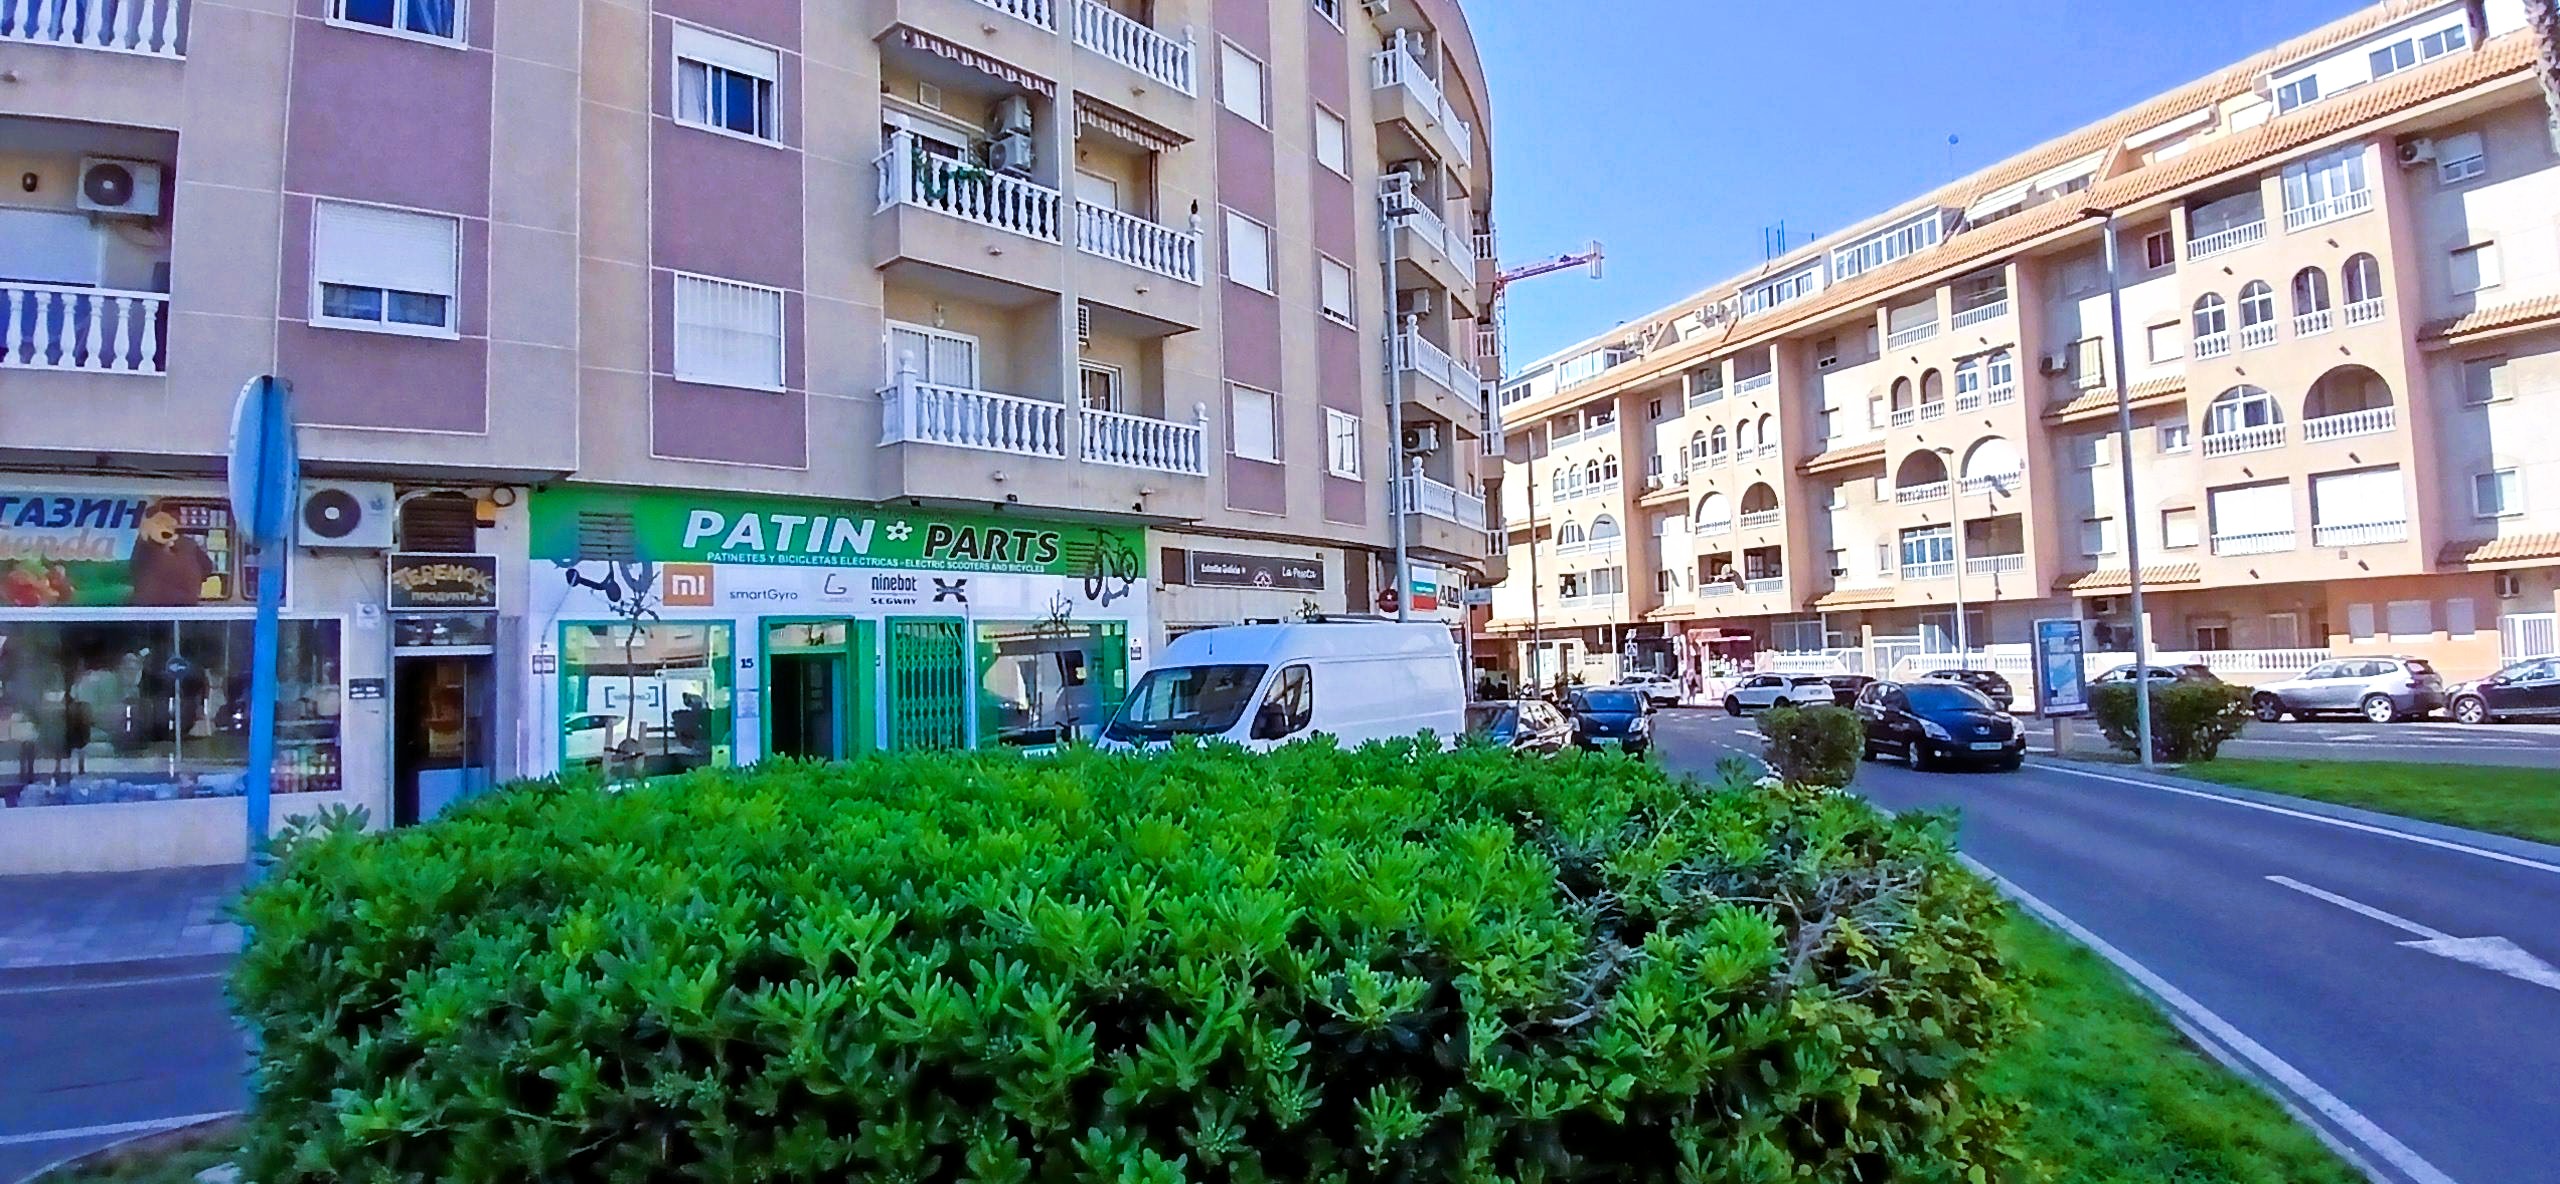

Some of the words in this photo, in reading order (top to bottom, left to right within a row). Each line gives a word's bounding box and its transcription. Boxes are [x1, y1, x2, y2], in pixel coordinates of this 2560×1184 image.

[682, 509, 876, 555] PATIN
[922, 522, 1061, 566] PARTS
[706, 551, 767, 563] PATINETES
[769, 554, 775, 563] Y
[777, 554, 838, 565] BICICLETAS
[839, 556, 898, 567] ELECTRICAS
[905, 560, 945, 569] ELECTRIC
[946, 561, 990, 571] SCOOTERS
[991, 563, 1008, 572] AND
[1008, 563, 1045, 573] BICYCLES
[871, 573, 918, 592] ninebot
[729, 588, 799, 602] smartGyro
[740, 658, 754, 669] 15
